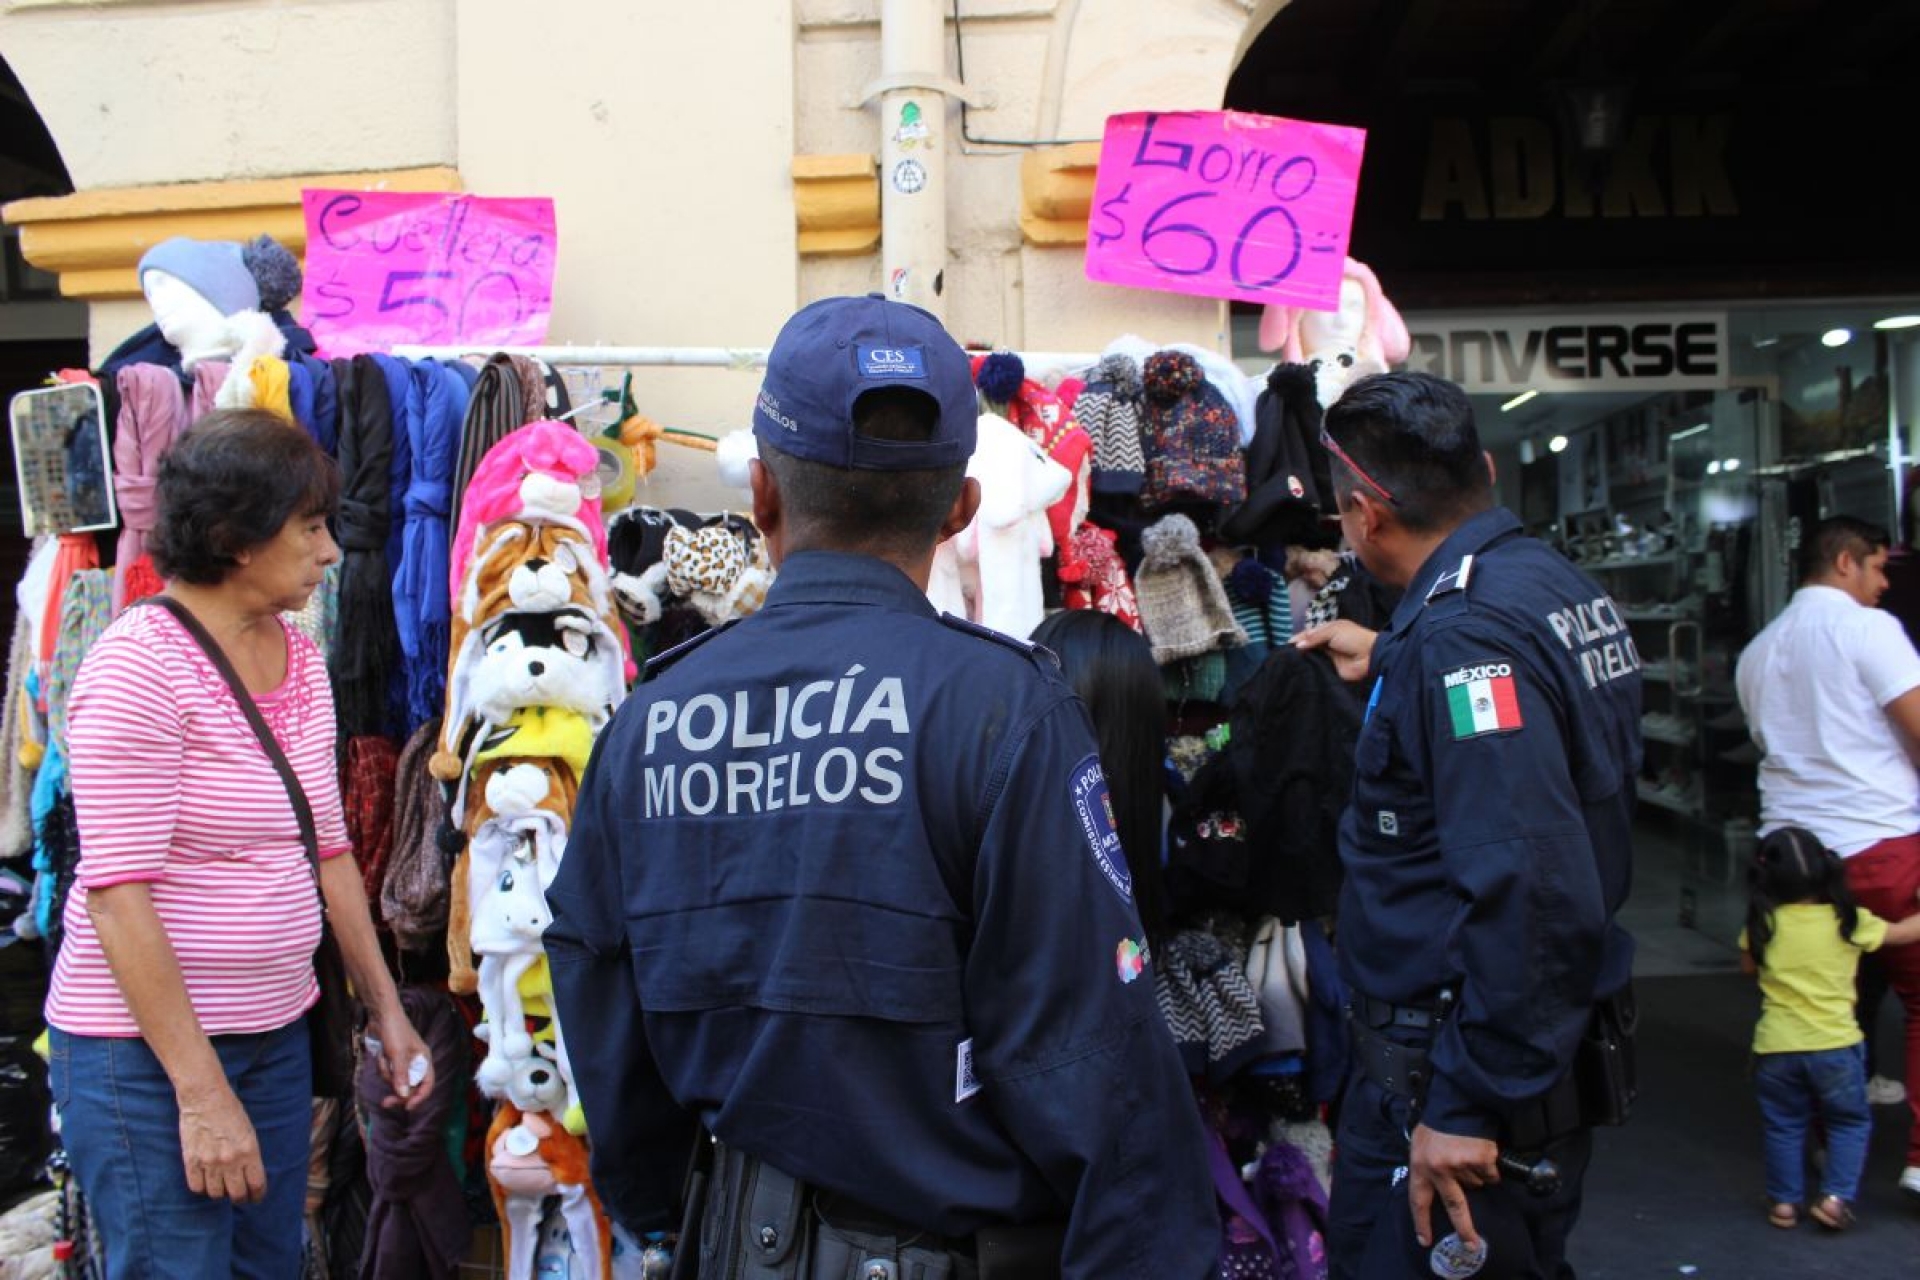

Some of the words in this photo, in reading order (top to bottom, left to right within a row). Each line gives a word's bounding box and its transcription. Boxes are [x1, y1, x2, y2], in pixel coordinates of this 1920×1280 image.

[1131, 113, 1317, 201] Gorro
[871, 349, 905, 363] CES
[1402, 322, 1718, 384] ONVERSE
[644, 663, 910, 755] POLICÍA
[1443, 663, 1511, 689] MÉXICO
[644, 746, 904, 818] MORELOS
